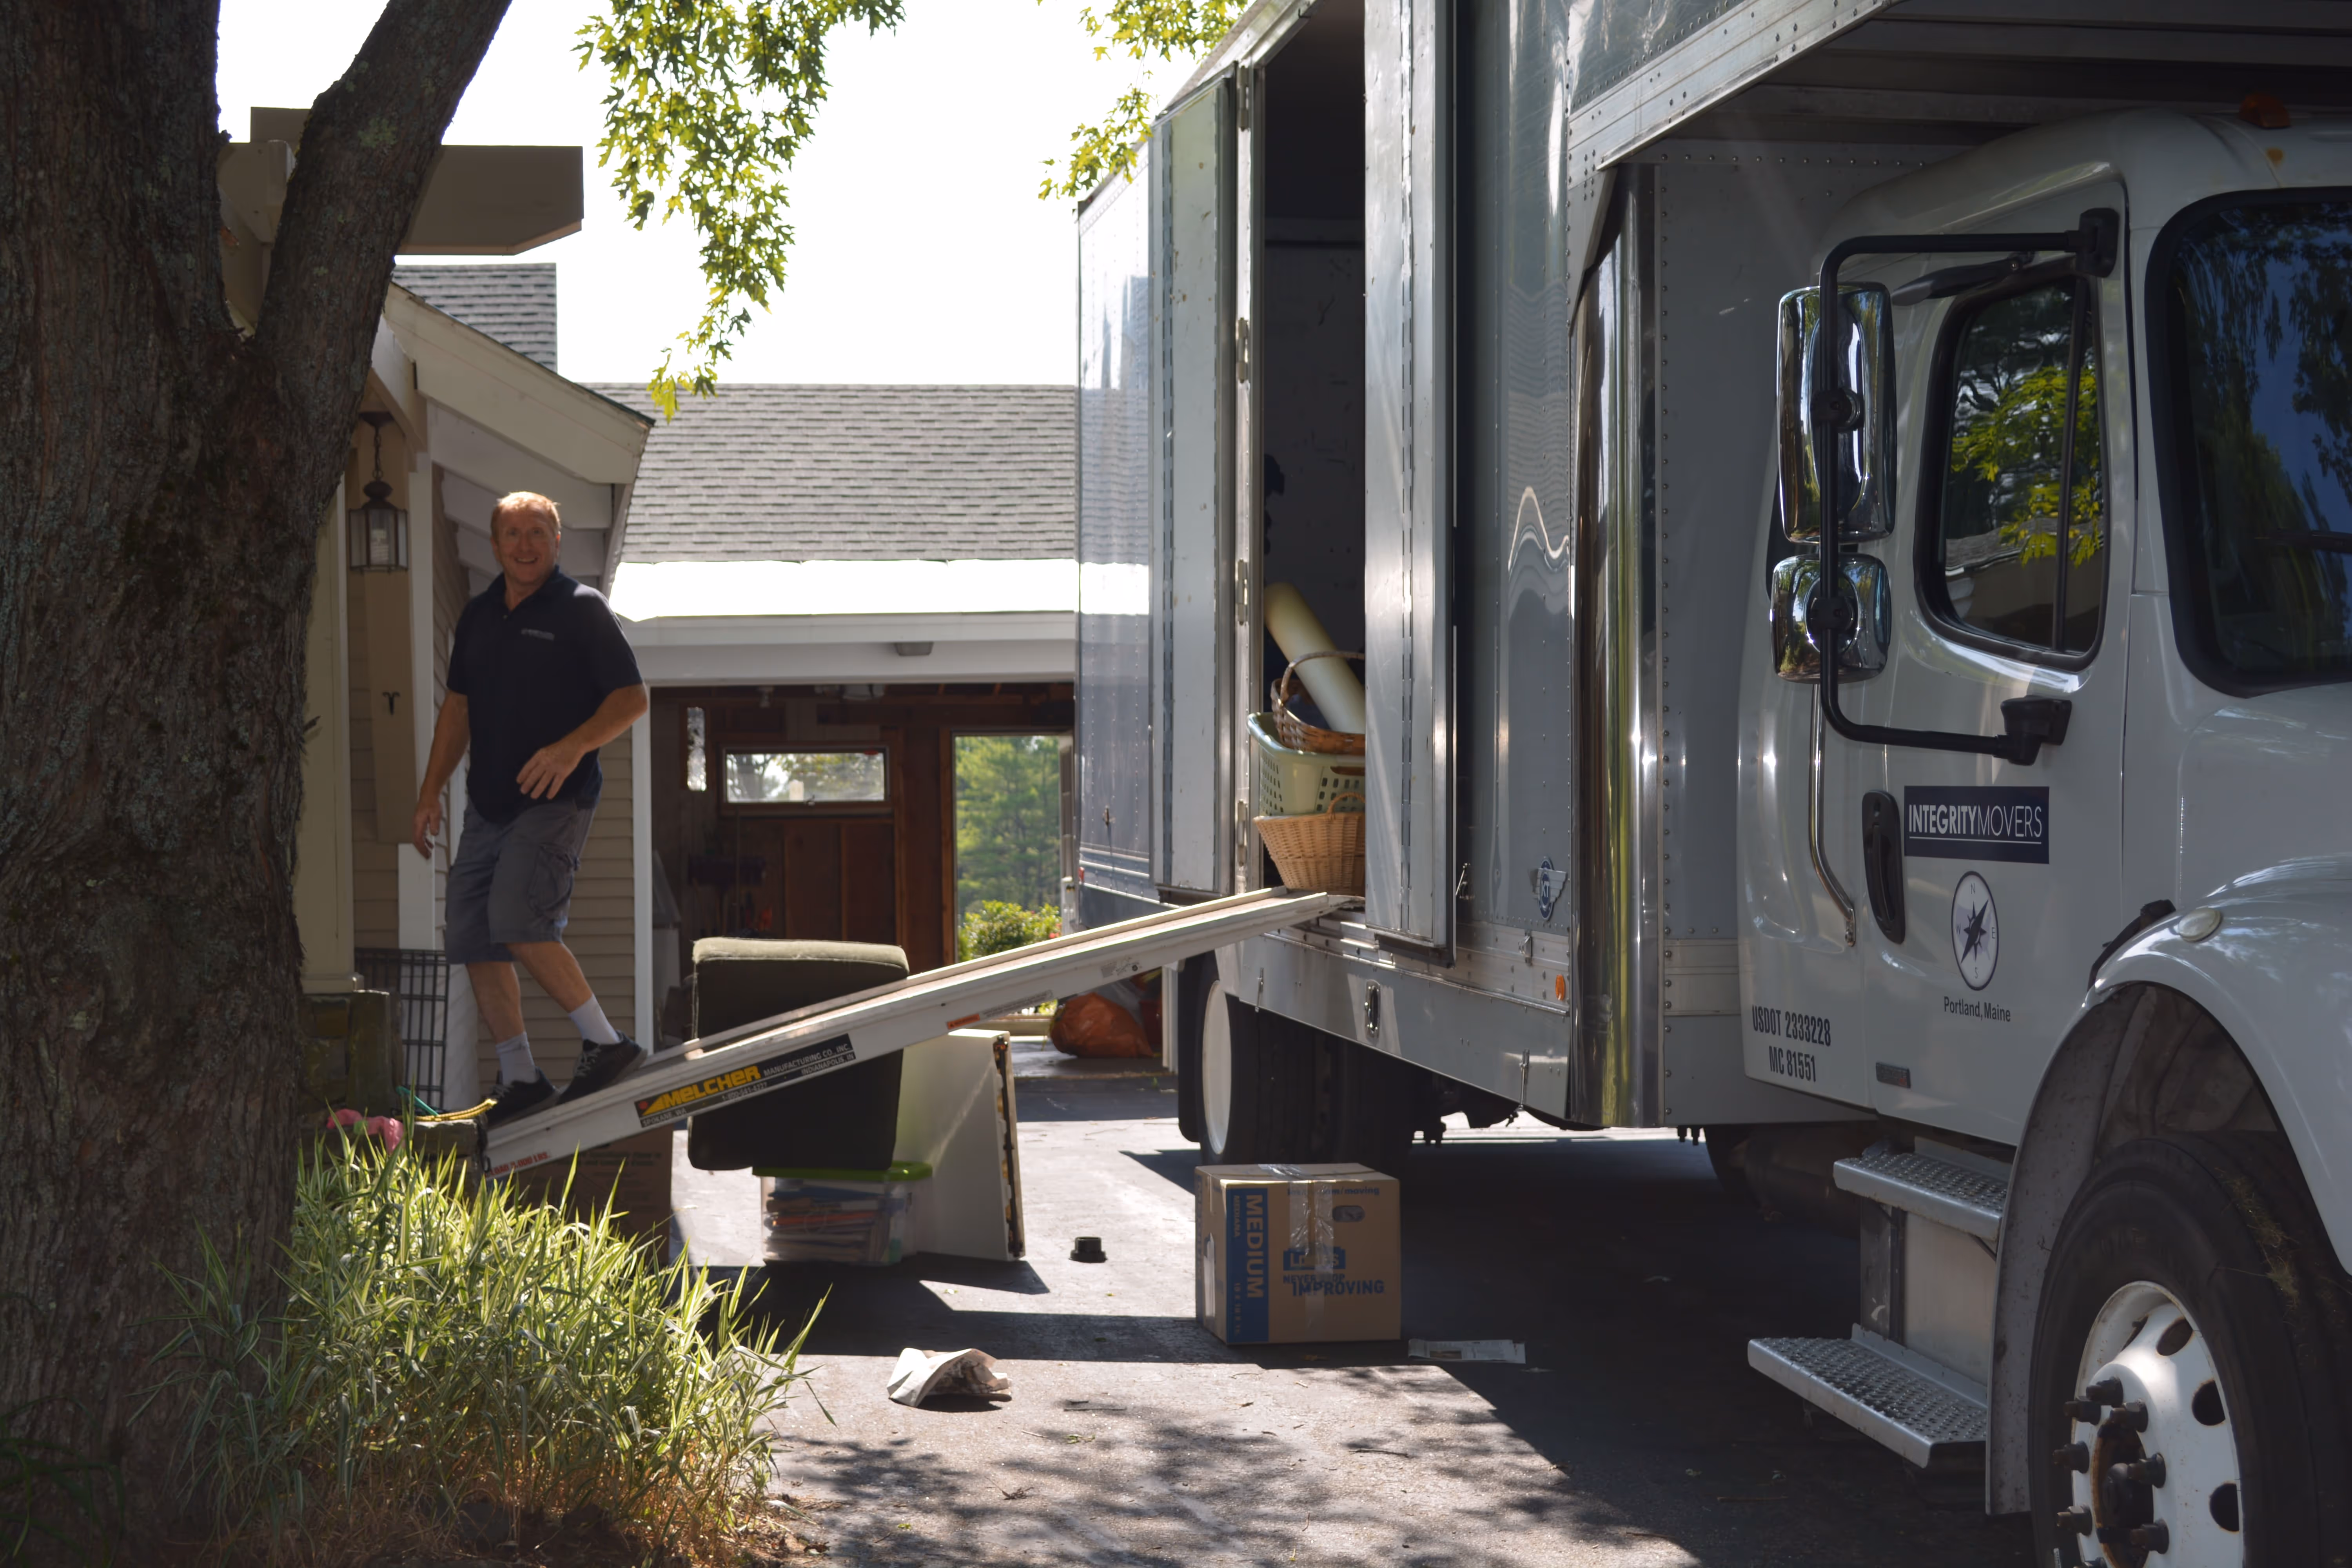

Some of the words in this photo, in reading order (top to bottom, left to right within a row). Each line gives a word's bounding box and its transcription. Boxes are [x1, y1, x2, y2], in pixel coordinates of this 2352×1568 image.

[1971, 883, 1975, 895] N
[1991, 927, 1996, 939] E
[1975, 967, 1978, 979] S
[1984, 1002, 2011, 1022] Maine
[1752, 1005, 1781, 1036] USDOT
[1785, 1011, 1831, 1047] 2333228
[763, 1050, 822, 1077] MANUFACTURING
[1769, 1045, 1784, 1074] MC
[1786, 1049, 1816, 1082] 81551
[1247, 1194, 1264, 1298] MEDIUM
[1292, 1279, 1385, 1297] IMPROVING
